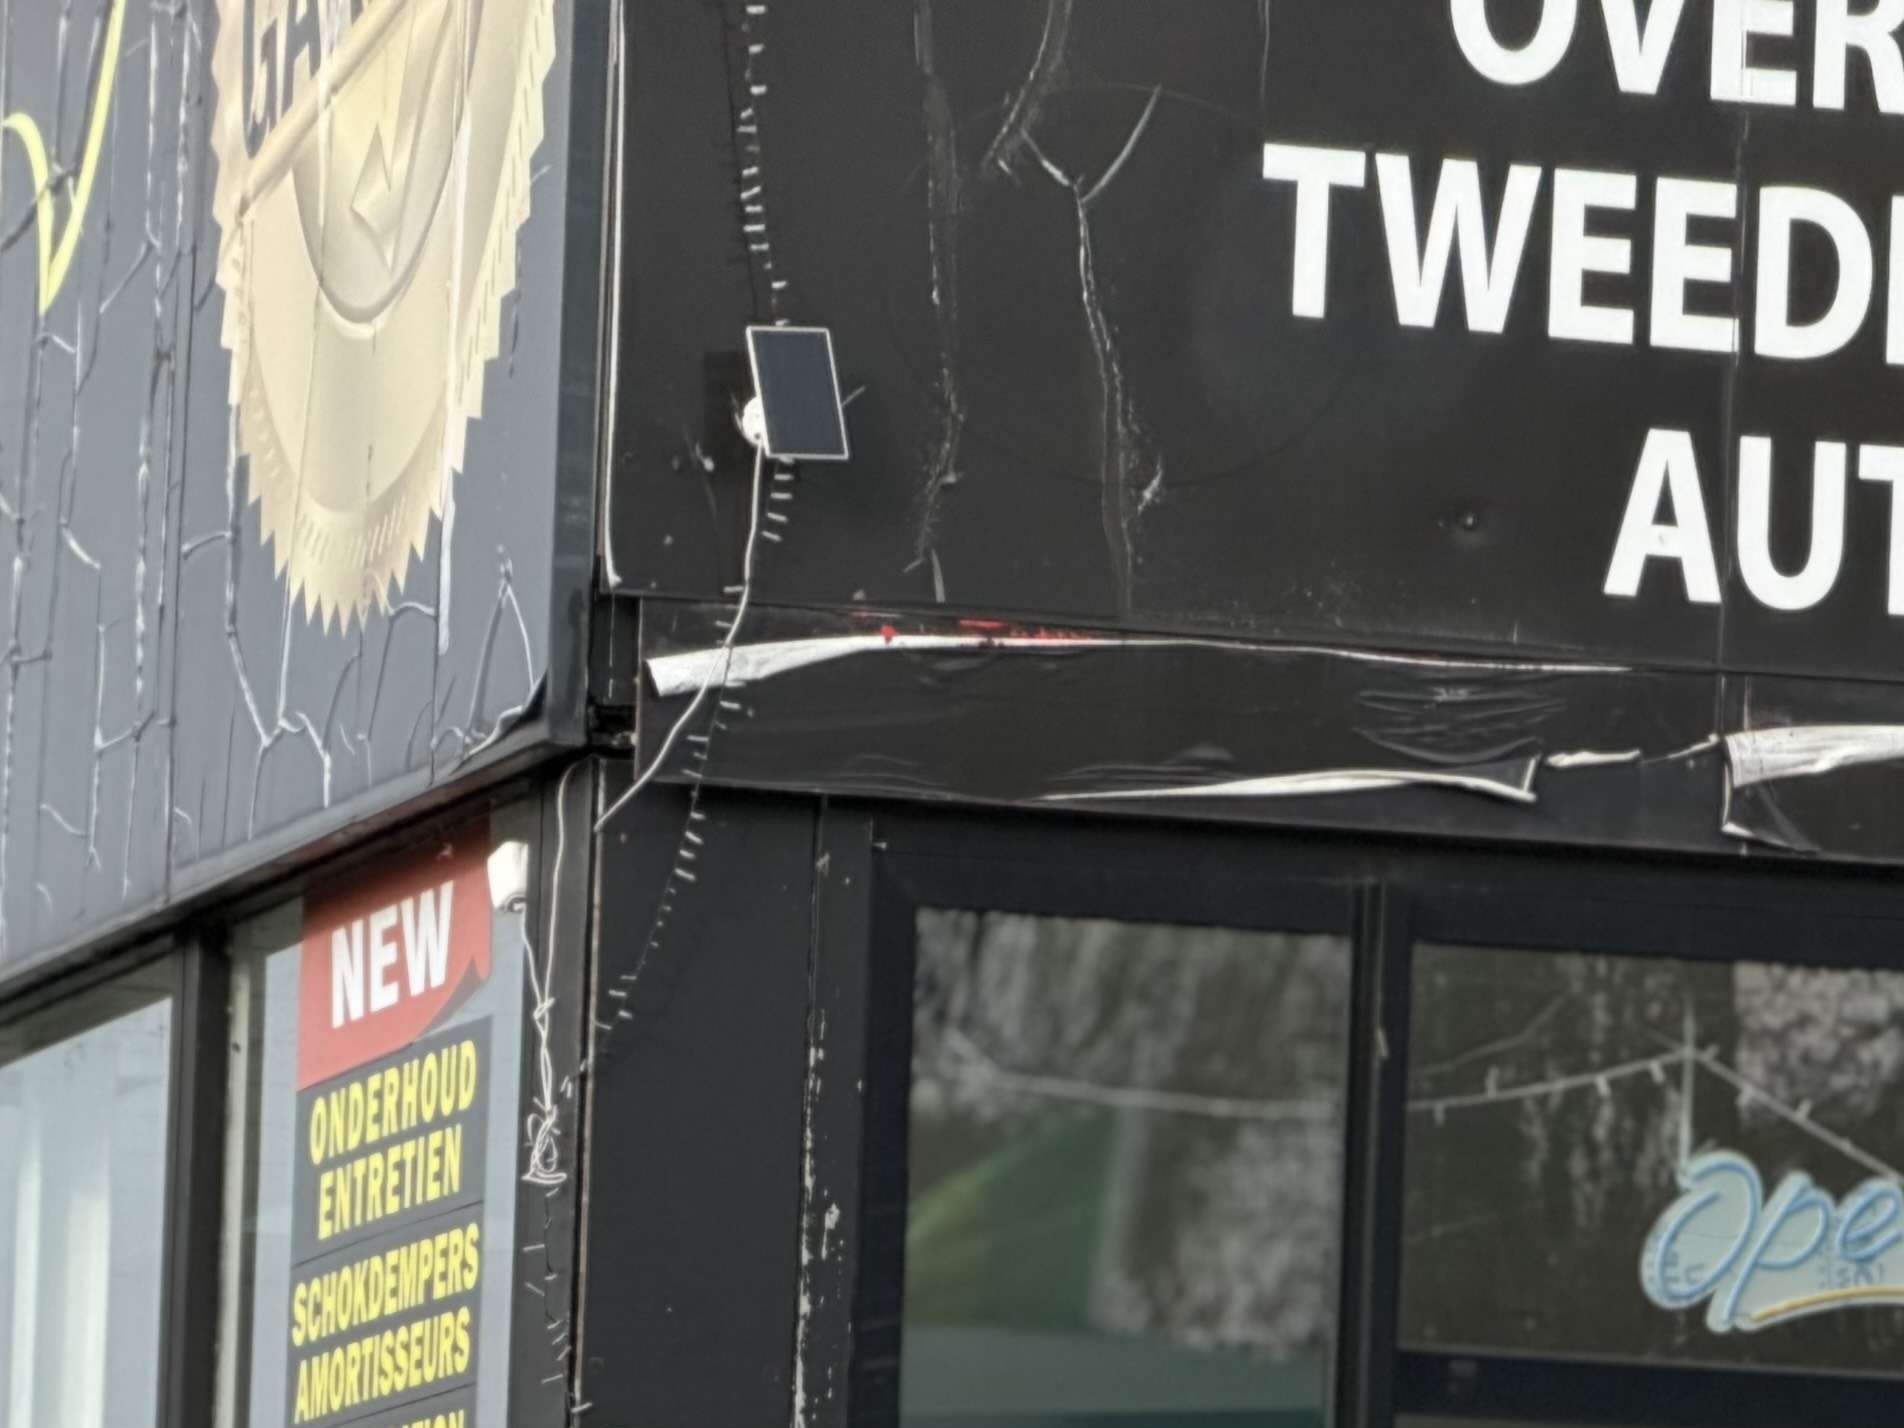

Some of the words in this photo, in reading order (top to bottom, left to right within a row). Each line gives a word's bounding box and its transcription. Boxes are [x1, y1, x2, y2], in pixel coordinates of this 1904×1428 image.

[330, 881, 454, 1029] NEW
[309, 1039, 476, 1165] ONDERHOUD
[317, 1125, 461, 1241] ENTRETIEN
[292, 1223, 479, 1347] SCHOKDEMPERS
[294, 1307, 471, 1425] AMORTISSEURS
